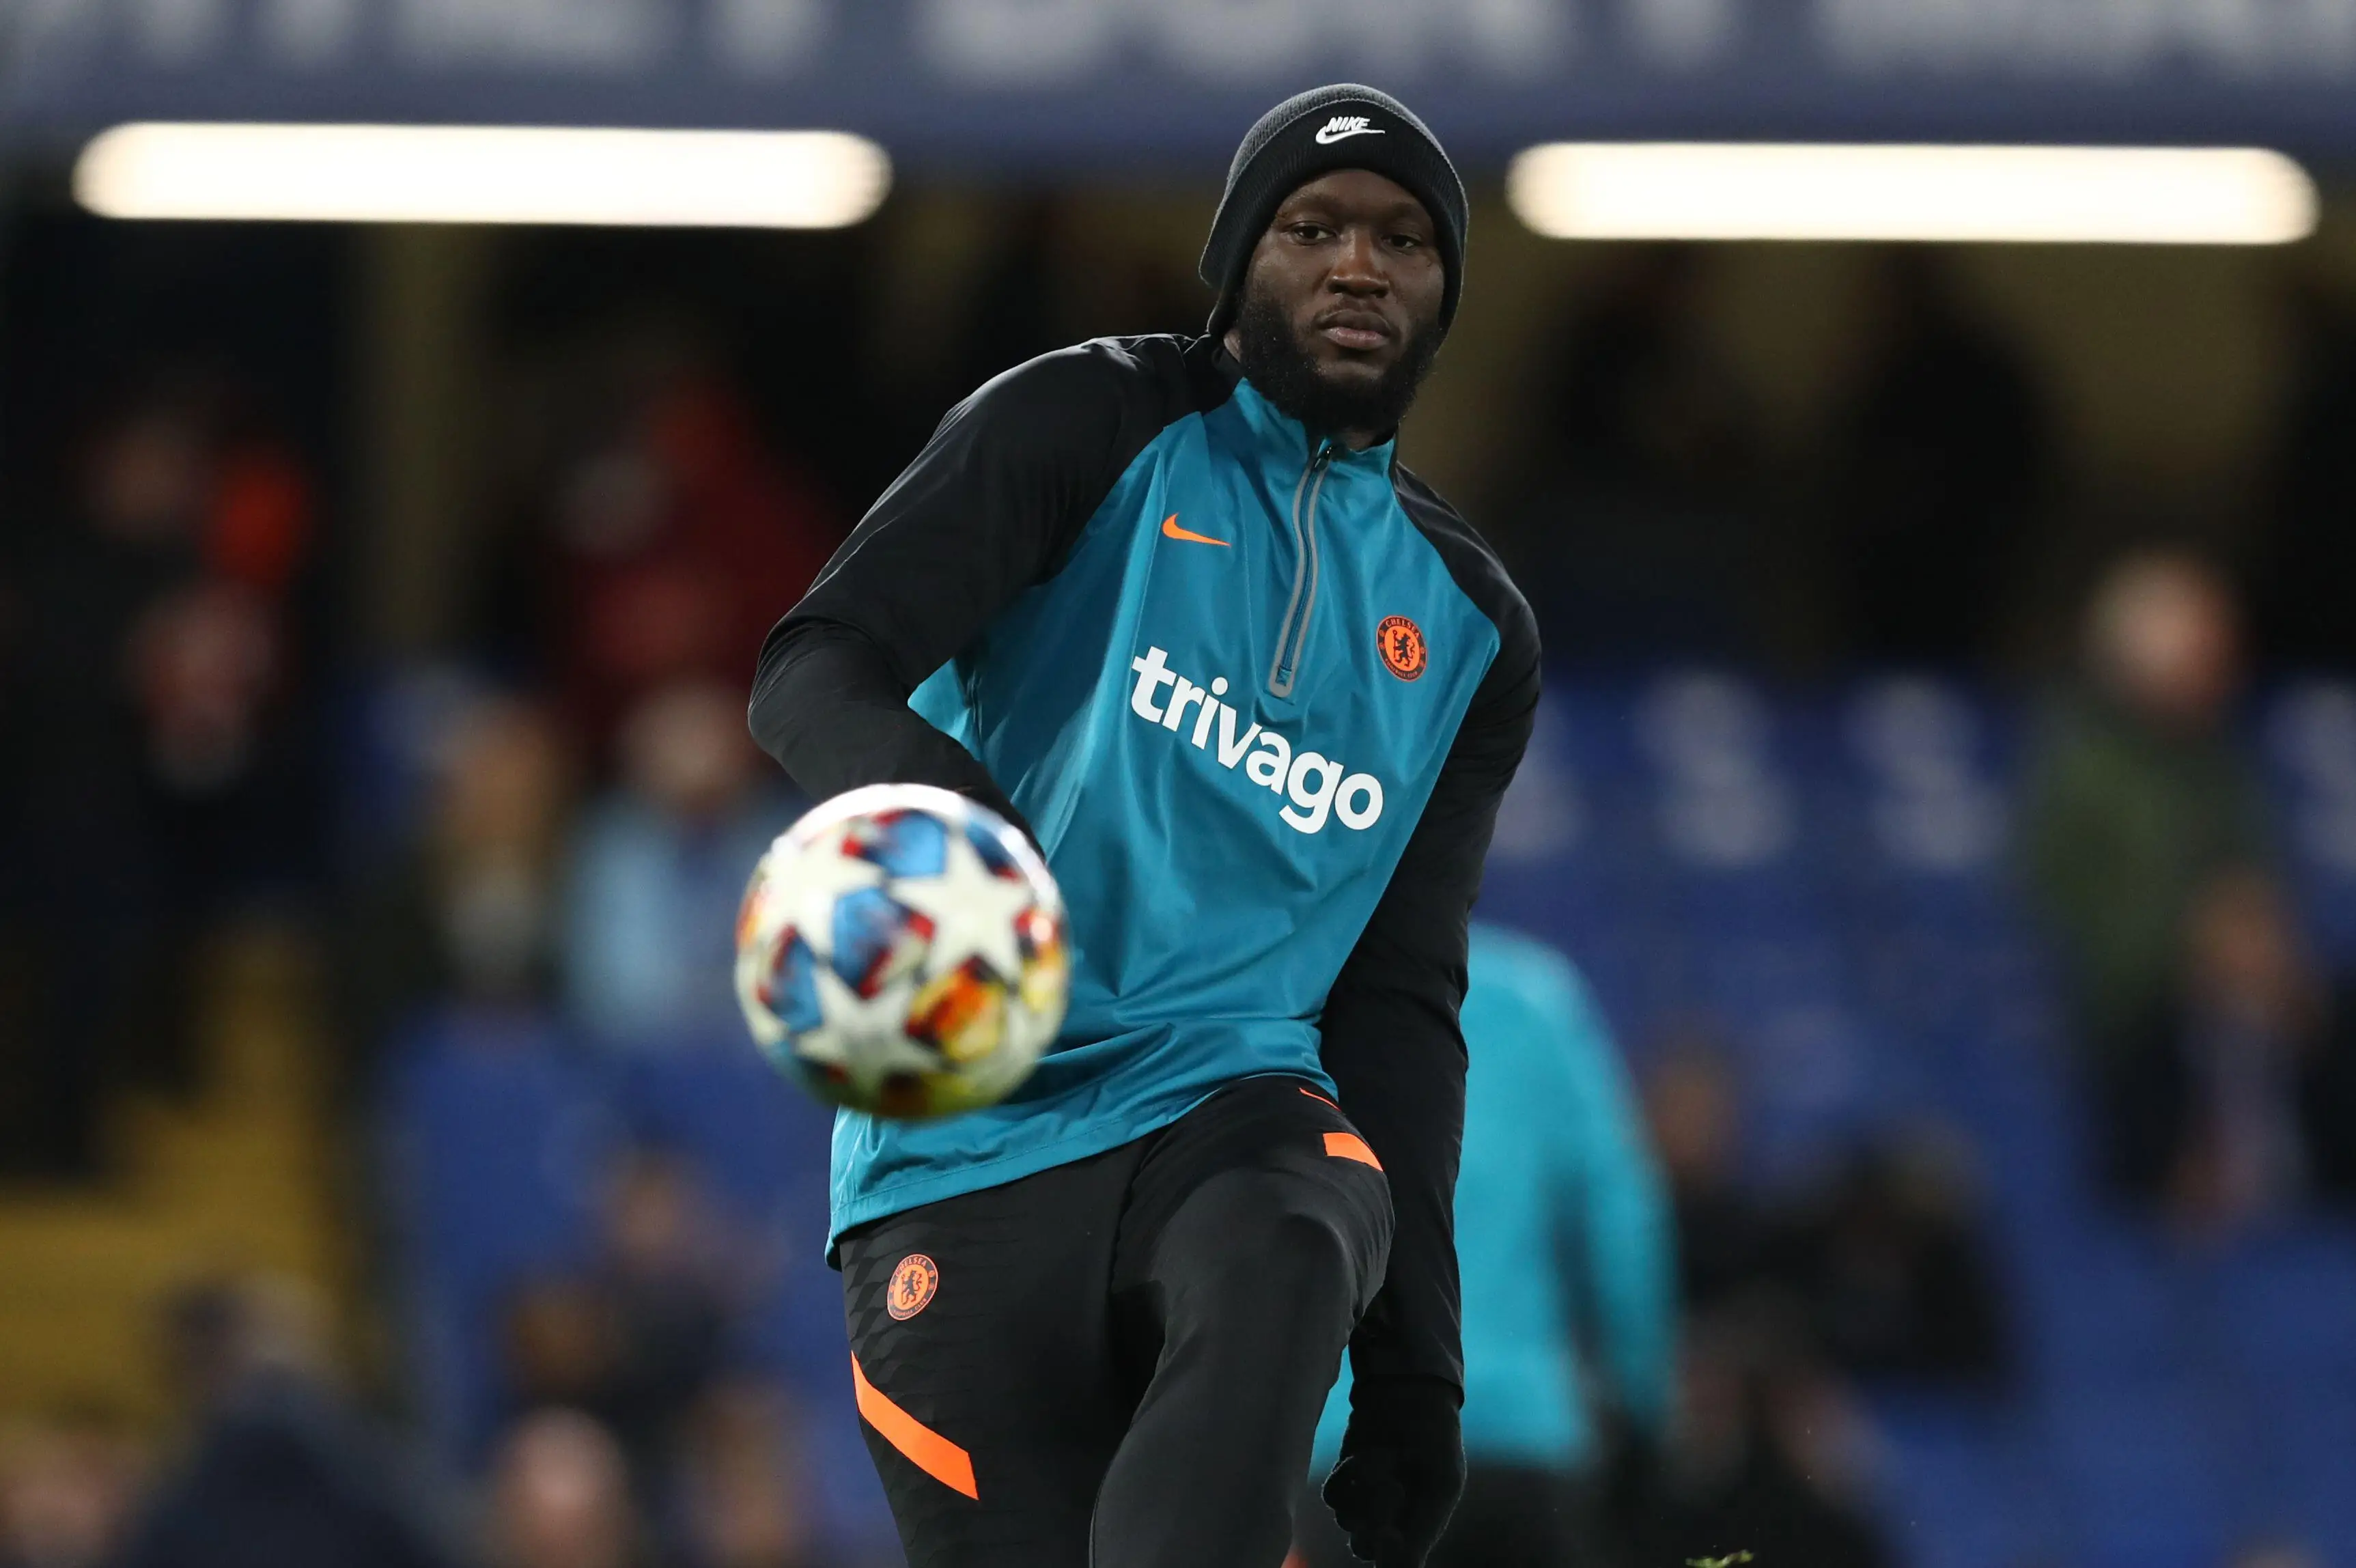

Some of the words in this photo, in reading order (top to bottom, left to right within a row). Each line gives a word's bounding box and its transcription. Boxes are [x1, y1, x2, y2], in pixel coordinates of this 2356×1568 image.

[1326, 116, 1370, 132] NIKE
[1386, 618, 1419, 638] CHELSEA
[1131, 645, 1384, 835] trivago
[896, 1257, 927, 1276] CHELSEA
